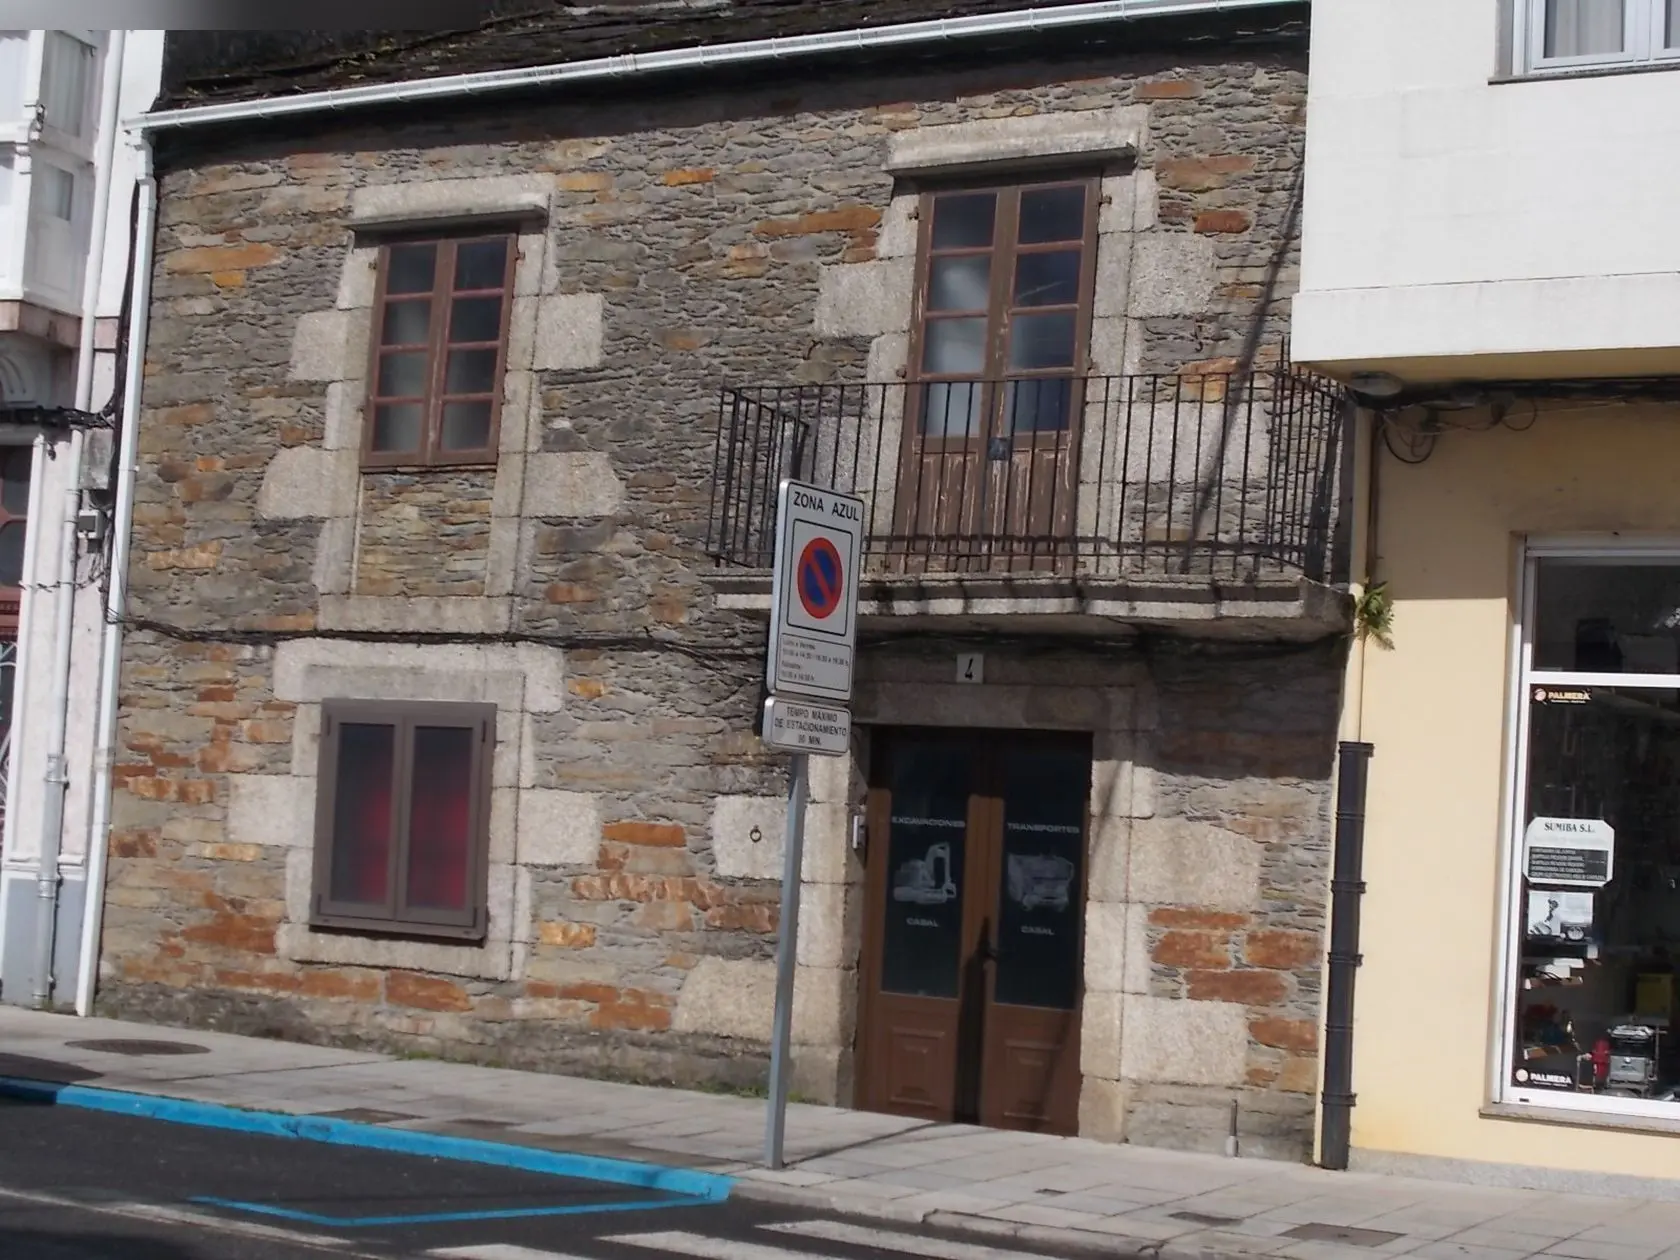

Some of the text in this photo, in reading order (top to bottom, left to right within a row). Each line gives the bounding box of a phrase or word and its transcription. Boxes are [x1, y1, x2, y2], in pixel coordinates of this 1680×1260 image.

[793, 491, 860, 522] ZONA AZUL
[1548, 690, 1592, 701] PALMERA
[786, 706, 809, 718] TEMPO
[774, 717, 847, 737] DE ESTACIONAMIENTO
[891, 816, 966, 828] EXCAVACIONES
[1007, 822, 1080, 834] TRANSPORTES
[906, 917, 939, 928] CASAL
[1020, 925, 1055, 936] CASAL
[1530, 1072, 1573, 1084] PALMERA
